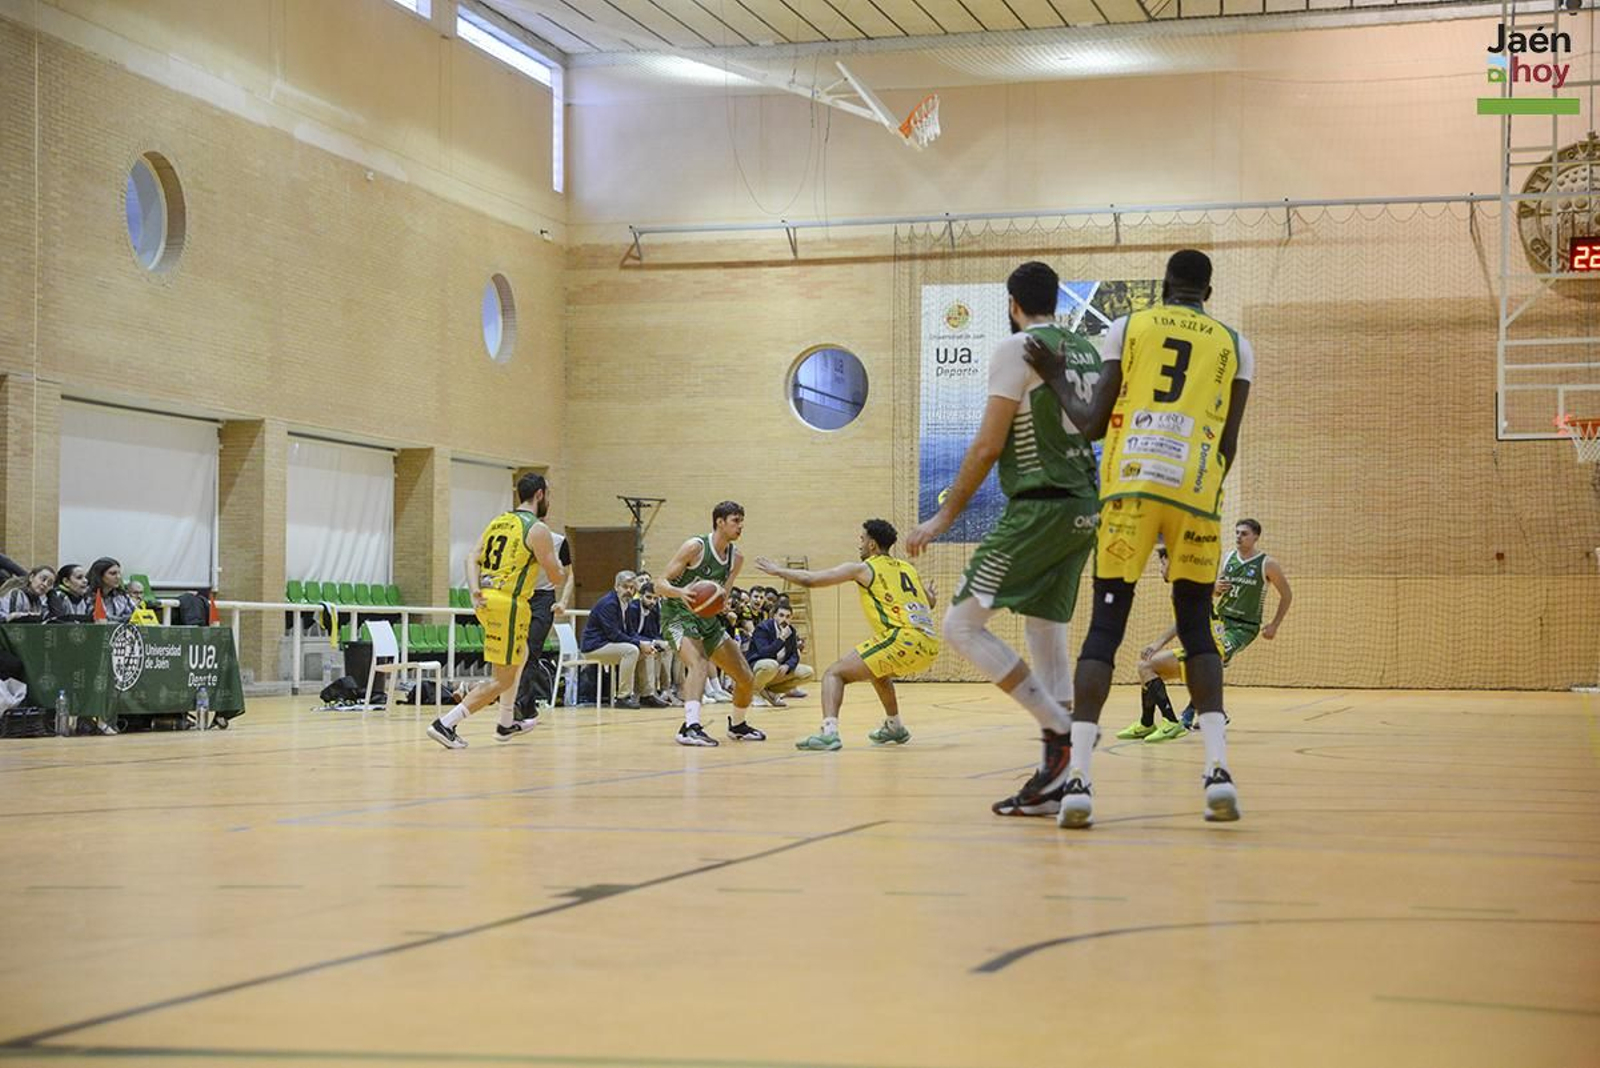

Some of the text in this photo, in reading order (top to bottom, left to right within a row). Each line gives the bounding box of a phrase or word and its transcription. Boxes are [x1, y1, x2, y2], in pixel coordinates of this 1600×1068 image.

[1180, 320, 1214, 335] SILVA
[936, 366, 979, 378] Deporte
[1153, 337, 1193, 403] 3
[1194, 443, 1211, 493] Domino's
[484, 535, 508, 570] 13
[900, 572, 918, 597] 4
[145, 643, 181, 657] Universidad
[145, 656, 170, 669] de Jaén
